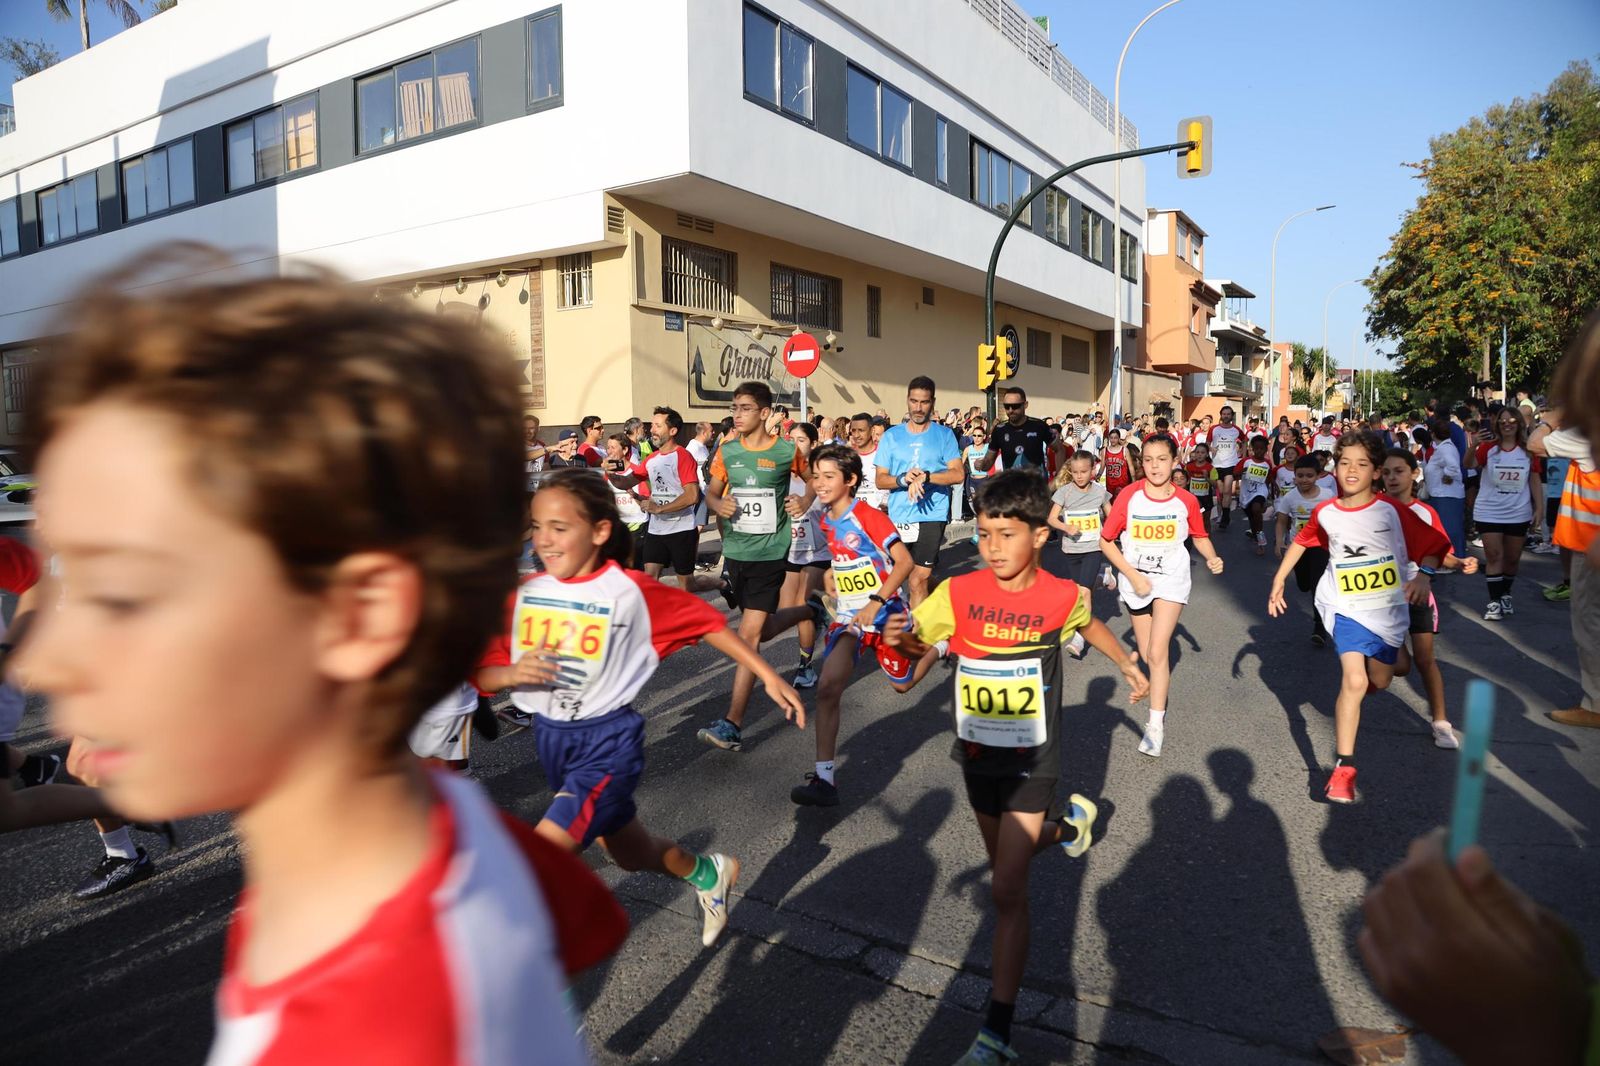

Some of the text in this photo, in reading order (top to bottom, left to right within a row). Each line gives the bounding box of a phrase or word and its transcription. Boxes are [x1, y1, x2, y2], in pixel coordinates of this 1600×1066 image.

[718, 344, 777, 387] Grand
[1107, 464, 1121, 478] 23
[1249, 467, 1267, 477] 1034
[1499, 471, 1520, 481] 712
[742, 502, 762, 517] 49
[1133, 524, 1176, 540] 1089
[836, 571, 877, 593] 1060
[1341, 567, 1397, 592] 1020
[968, 604, 1045, 630] Málaga
[522, 616, 602, 655] 1126
[983, 623, 1042, 643] Bahía
[962, 683, 1037, 716] 1012
